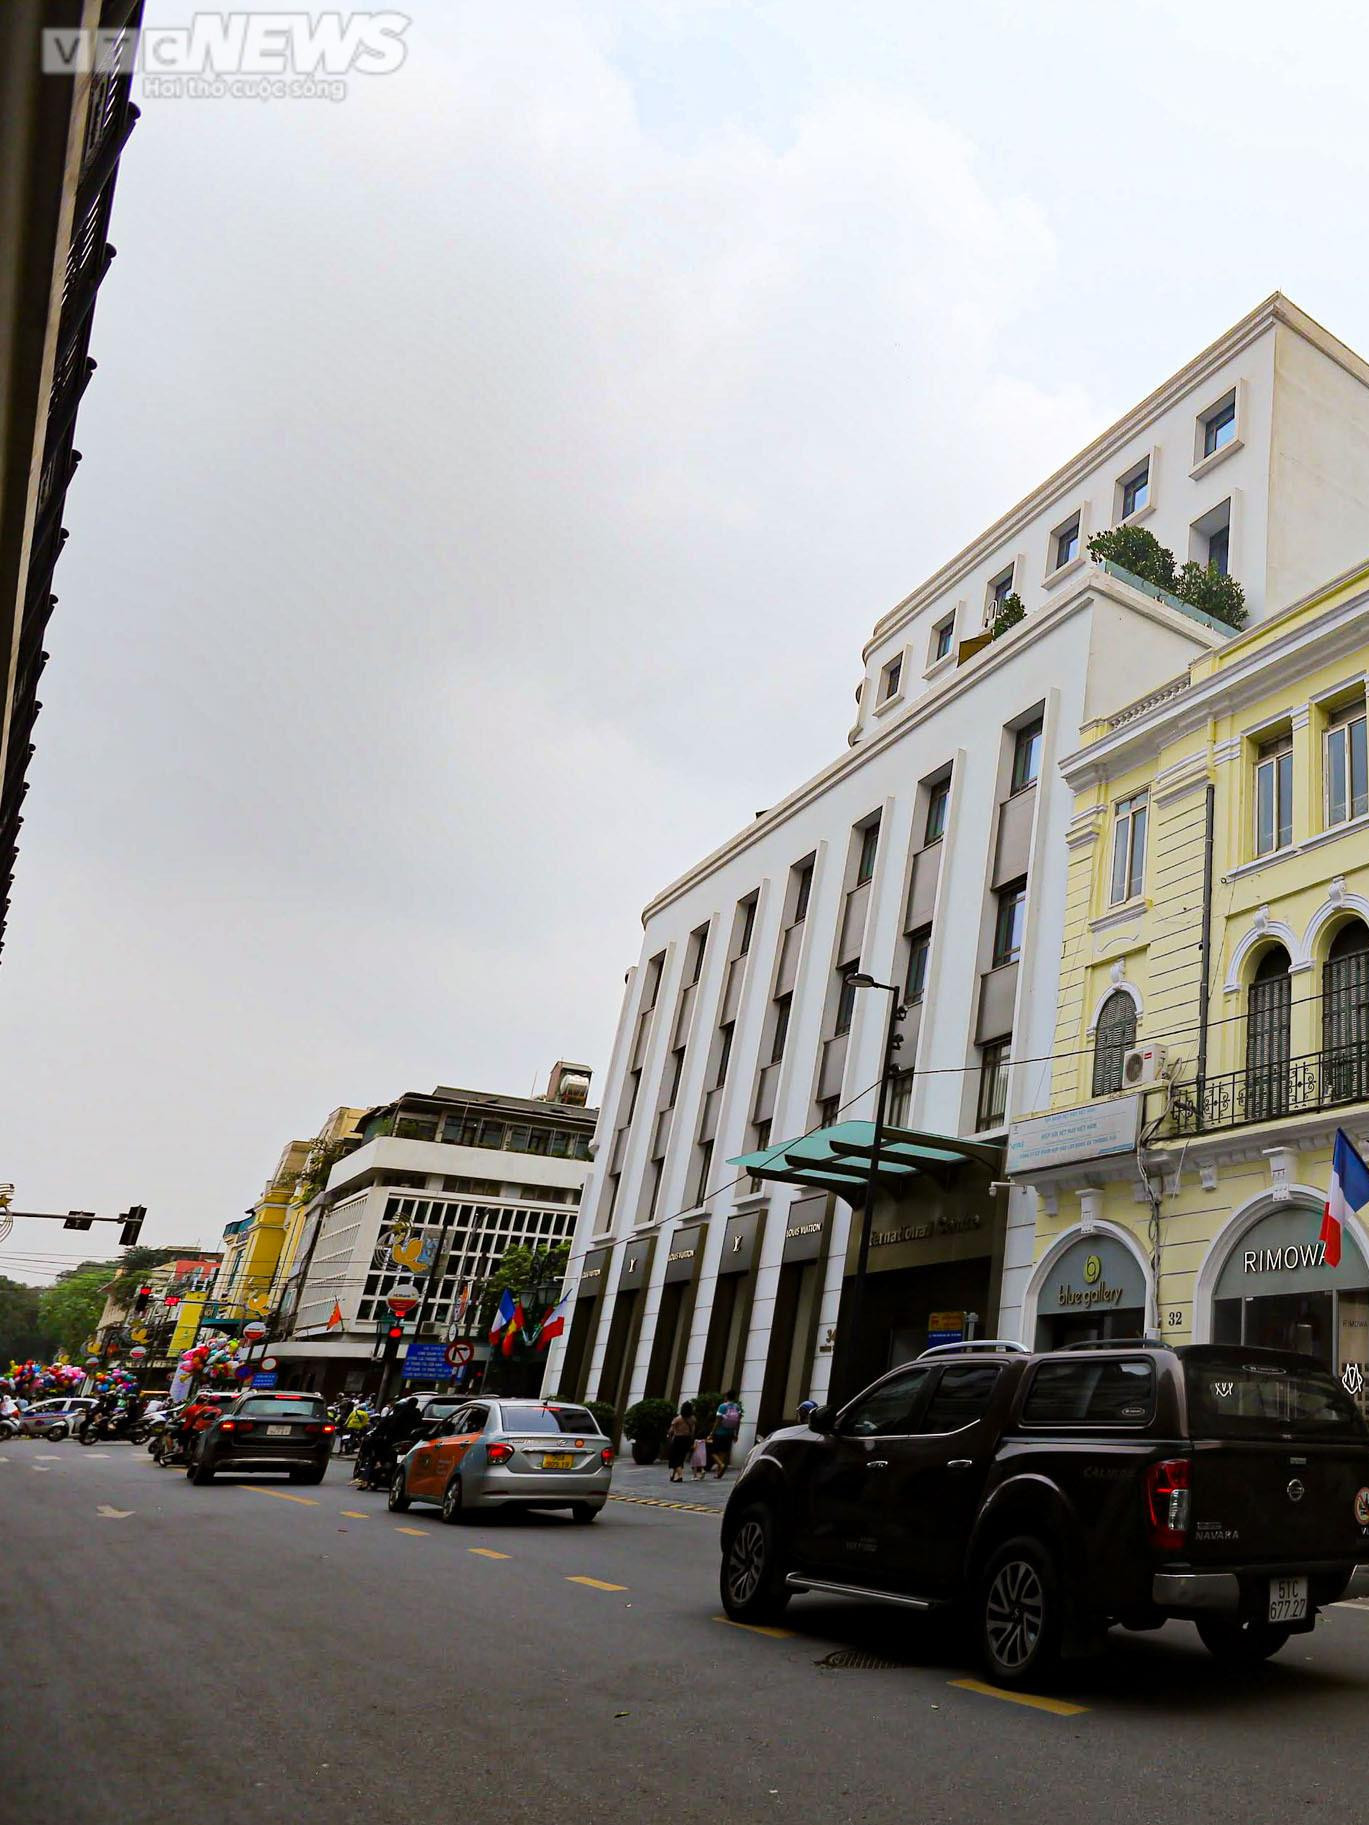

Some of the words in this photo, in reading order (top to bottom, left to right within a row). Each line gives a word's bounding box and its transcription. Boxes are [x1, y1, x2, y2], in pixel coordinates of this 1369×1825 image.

[1058, 1285, 1084, 1305] blue
[1084, 1281, 1123, 1309] gallery
[1168, 1311, 1182, 1327] 32
[1195, 1529, 1240, 1541] NAVARA
[1279, 1580, 1299, 1599] 51C
[1270, 1598, 1306, 1620] 677.27
